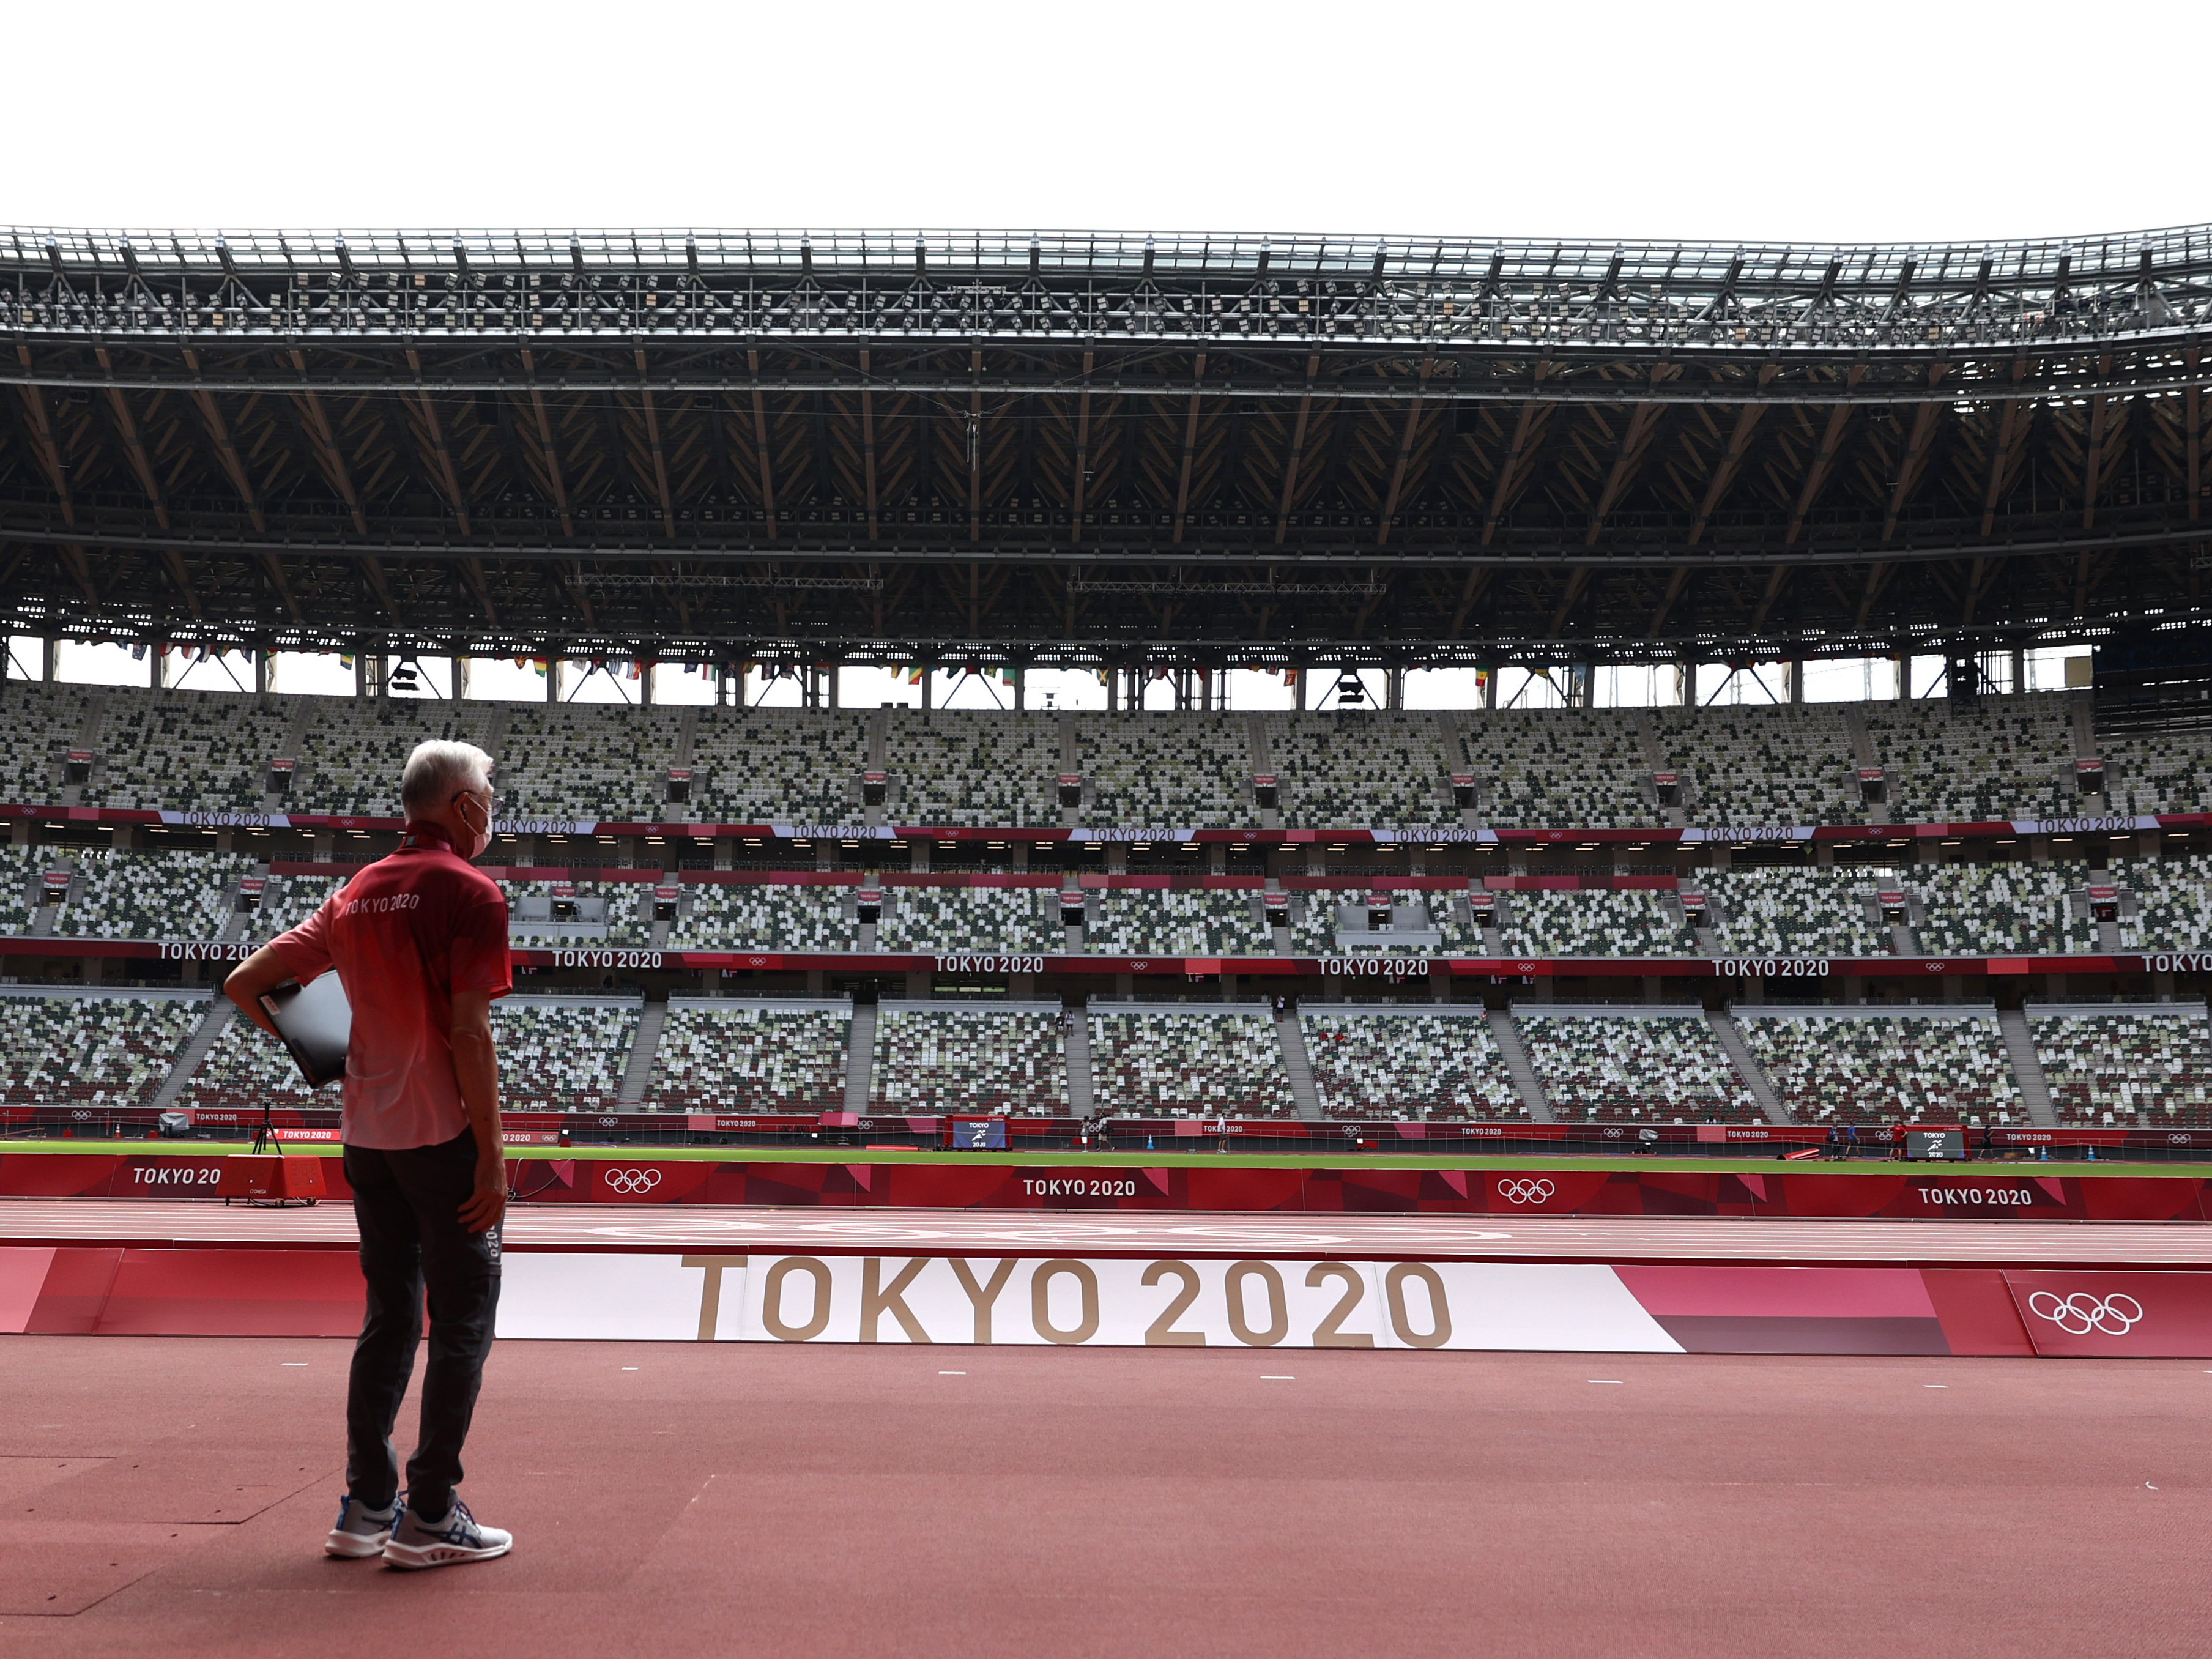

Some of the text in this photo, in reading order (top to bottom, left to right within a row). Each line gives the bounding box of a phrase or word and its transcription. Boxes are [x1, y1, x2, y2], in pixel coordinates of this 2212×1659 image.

[180, 812, 270, 827] TOKYO 2020
[492, 820, 576, 834] TOKYO 2020
[2035, 818, 2136, 833] TOKYO 2020
[792, 826, 876, 839] TOKYO 2020
[1089, 828, 1175, 842] TOKYO 2020
[1390, 829, 1477, 842] TOKYO 2020
[1702, 828, 1793, 841] TOKYO 2020
[346, 893, 420, 916] TOKYO 2020
[158, 943, 221, 960] TOKYO
[552, 951, 662, 968] TOKYO 2020
[935, 956, 1044, 973] TOKYO 2020
[1318, 959, 1428, 976] TOKYO 2020
[1712, 960, 1829, 977] TOKYO 2020
[283, 1130, 332, 1139] TOKYO 2020
[510, 1134, 530, 1143] 2020
[133, 1168, 220, 1184] TOKYO 20
[1023, 1179, 1135, 1196] TOKYO 2020
[1918, 1189, 2032, 1206] TOKYO 2020
[681, 1254, 1452, 1348] TOKYO 2020
